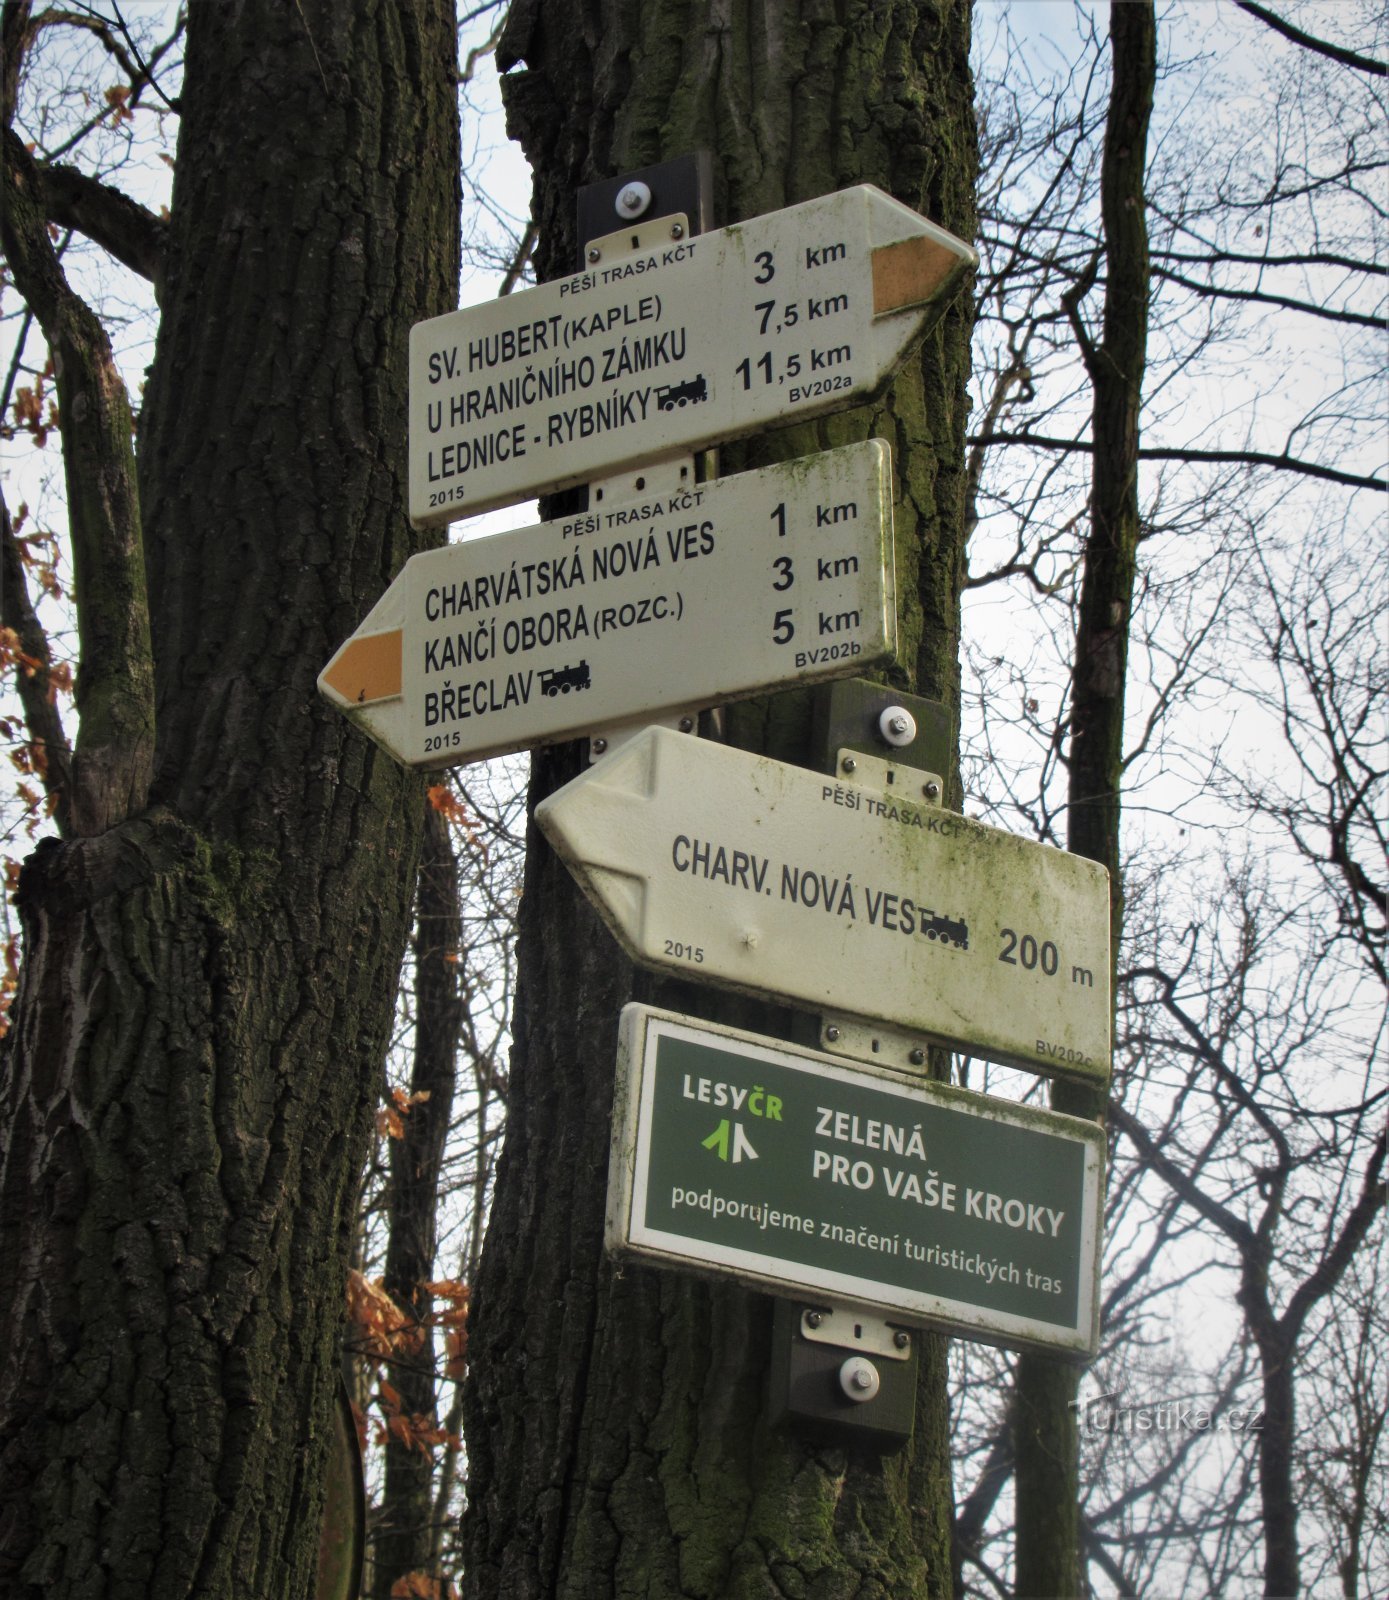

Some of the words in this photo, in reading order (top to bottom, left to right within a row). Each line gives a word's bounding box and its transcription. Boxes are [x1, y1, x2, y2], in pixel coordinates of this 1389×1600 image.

[560, 272, 596, 298] PĚŠÍ
[602, 257, 658, 284] TRASA
[662, 244, 696, 266] KČT
[754, 251, 775, 284] 3
[806, 242, 846, 269] km
[754, 299, 799, 336] 7,5
[808, 293, 848, 320] km
[428, 347, 461, 384] SV.
[428, 400, 442, 434] U
[451, 355, 595, 428] HRANIČNÍHO
[602, 326, 686, 383] ZÁMKU
[735, 351, 801, 391] 11,5
[810, 344, 852, 371] km
[789, 375, 853, 403] BV202a
[428, 423, 526, 483] LEDNICE
[548, 386, 651, 448] RYBNÍKY
[429, 485, 464, 508] 2015
[562, 513, 600, 540] PĚŠÍ
[605, 501, 664, 529] TRASA
[668, 491, 704, 514] KČT
[770, 503, 786, 537] 1
[816, 502, 858, 528] km
[425, 545, 585, 622] CHARVÁTSKÁ
[592, 527, 661, 583] NOVÁ
[666, 520, 715, 564] VES
[772, 556, 794, 592] 3
[817, 555, 859, 581] km
[424, 617, 496, 674] KANČÍ
[503, 604, 590, 655] OBORA
[772, 609, 795, 645] 5
[818, 610, 860, 635] km
[795, 641, 861, 668] BV202b
[424, 669, 534, 727] BŘECLAV
[424, 731, 461, 752] 2015
[822, 784, 861, 811] PĚŠÍ
[865, 799, 923, 829] TRASA
[927, 819, 962, 839] KČT
[672, 834, 771, 896] CHARV.
[780, 864, 856, 920] NOVÁ
[865, 887, 916, 935] VES
[664, 940, 704, 963] 2015
[998, 928, 1059, 976] 200
[1072, 965, 1093, 988] m
[1036, 1039, 1092, 1069] BV202c
[815, 1106, 927, 1161] ZELENÁ
[813, 1150, 874, 1190] PRO
[882, 1167, 956, 1212] VAŠE
[965, 1188, 1064, 1237] KROKY
[672, 1187, 814, 1234] podporujeme
[821, 1221, 898, 1254] značení
[904, 1238, 1020, 1284] turistických
[1025, 1268, 1062, 1294] tras
